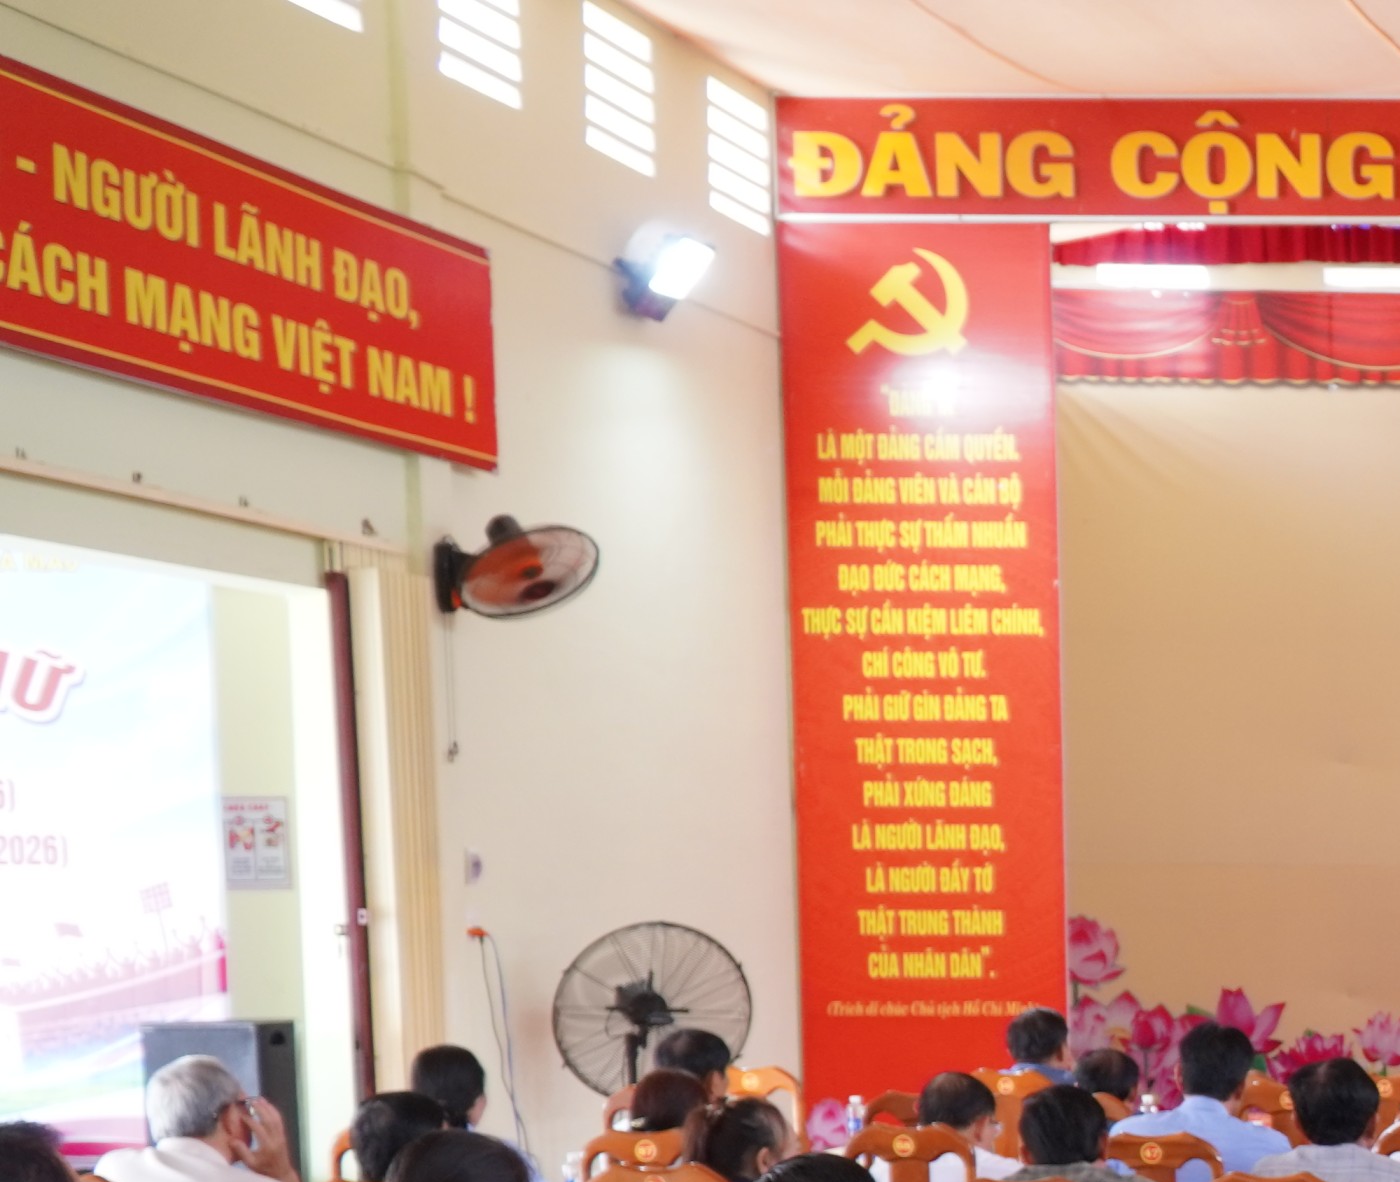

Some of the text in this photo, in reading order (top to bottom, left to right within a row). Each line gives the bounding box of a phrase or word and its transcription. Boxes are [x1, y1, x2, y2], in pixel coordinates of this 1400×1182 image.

[791, 104, 1077, 201] ĐẢNG
[1110, 110, 1397, 214] CỘNG
[52, 142, 200, 249] NGƯỜI
[212, 201, 323, 293] LÃNH
[332, 247, 422, 330] ĐẠO,
[0, 220, 110, 318] ÁCH
[124, 267, 261, 358] MẠNG
[272, 316, 358, 394] VIỆT
[367, 349, 455, 418] NAM
[855, 734, 894, 767] THẬT
[896, 738, 948, 764] TRONG
[863, 775, 992, 807] PHẢI XỨNG ĐÁNG
[852, 820, 872, 850] LÀ
[875, 820, 923, 850] NGƯỜI
[926, 820, 967, 850] LÃNH
[866, 863, 886, 892] LÀ
[889, 863, 937, 892] NGƯỜI
[972, 863, 993, 892] TỚ
[857, 906, 1004, 939] THẬT TRUNG THÀNH
